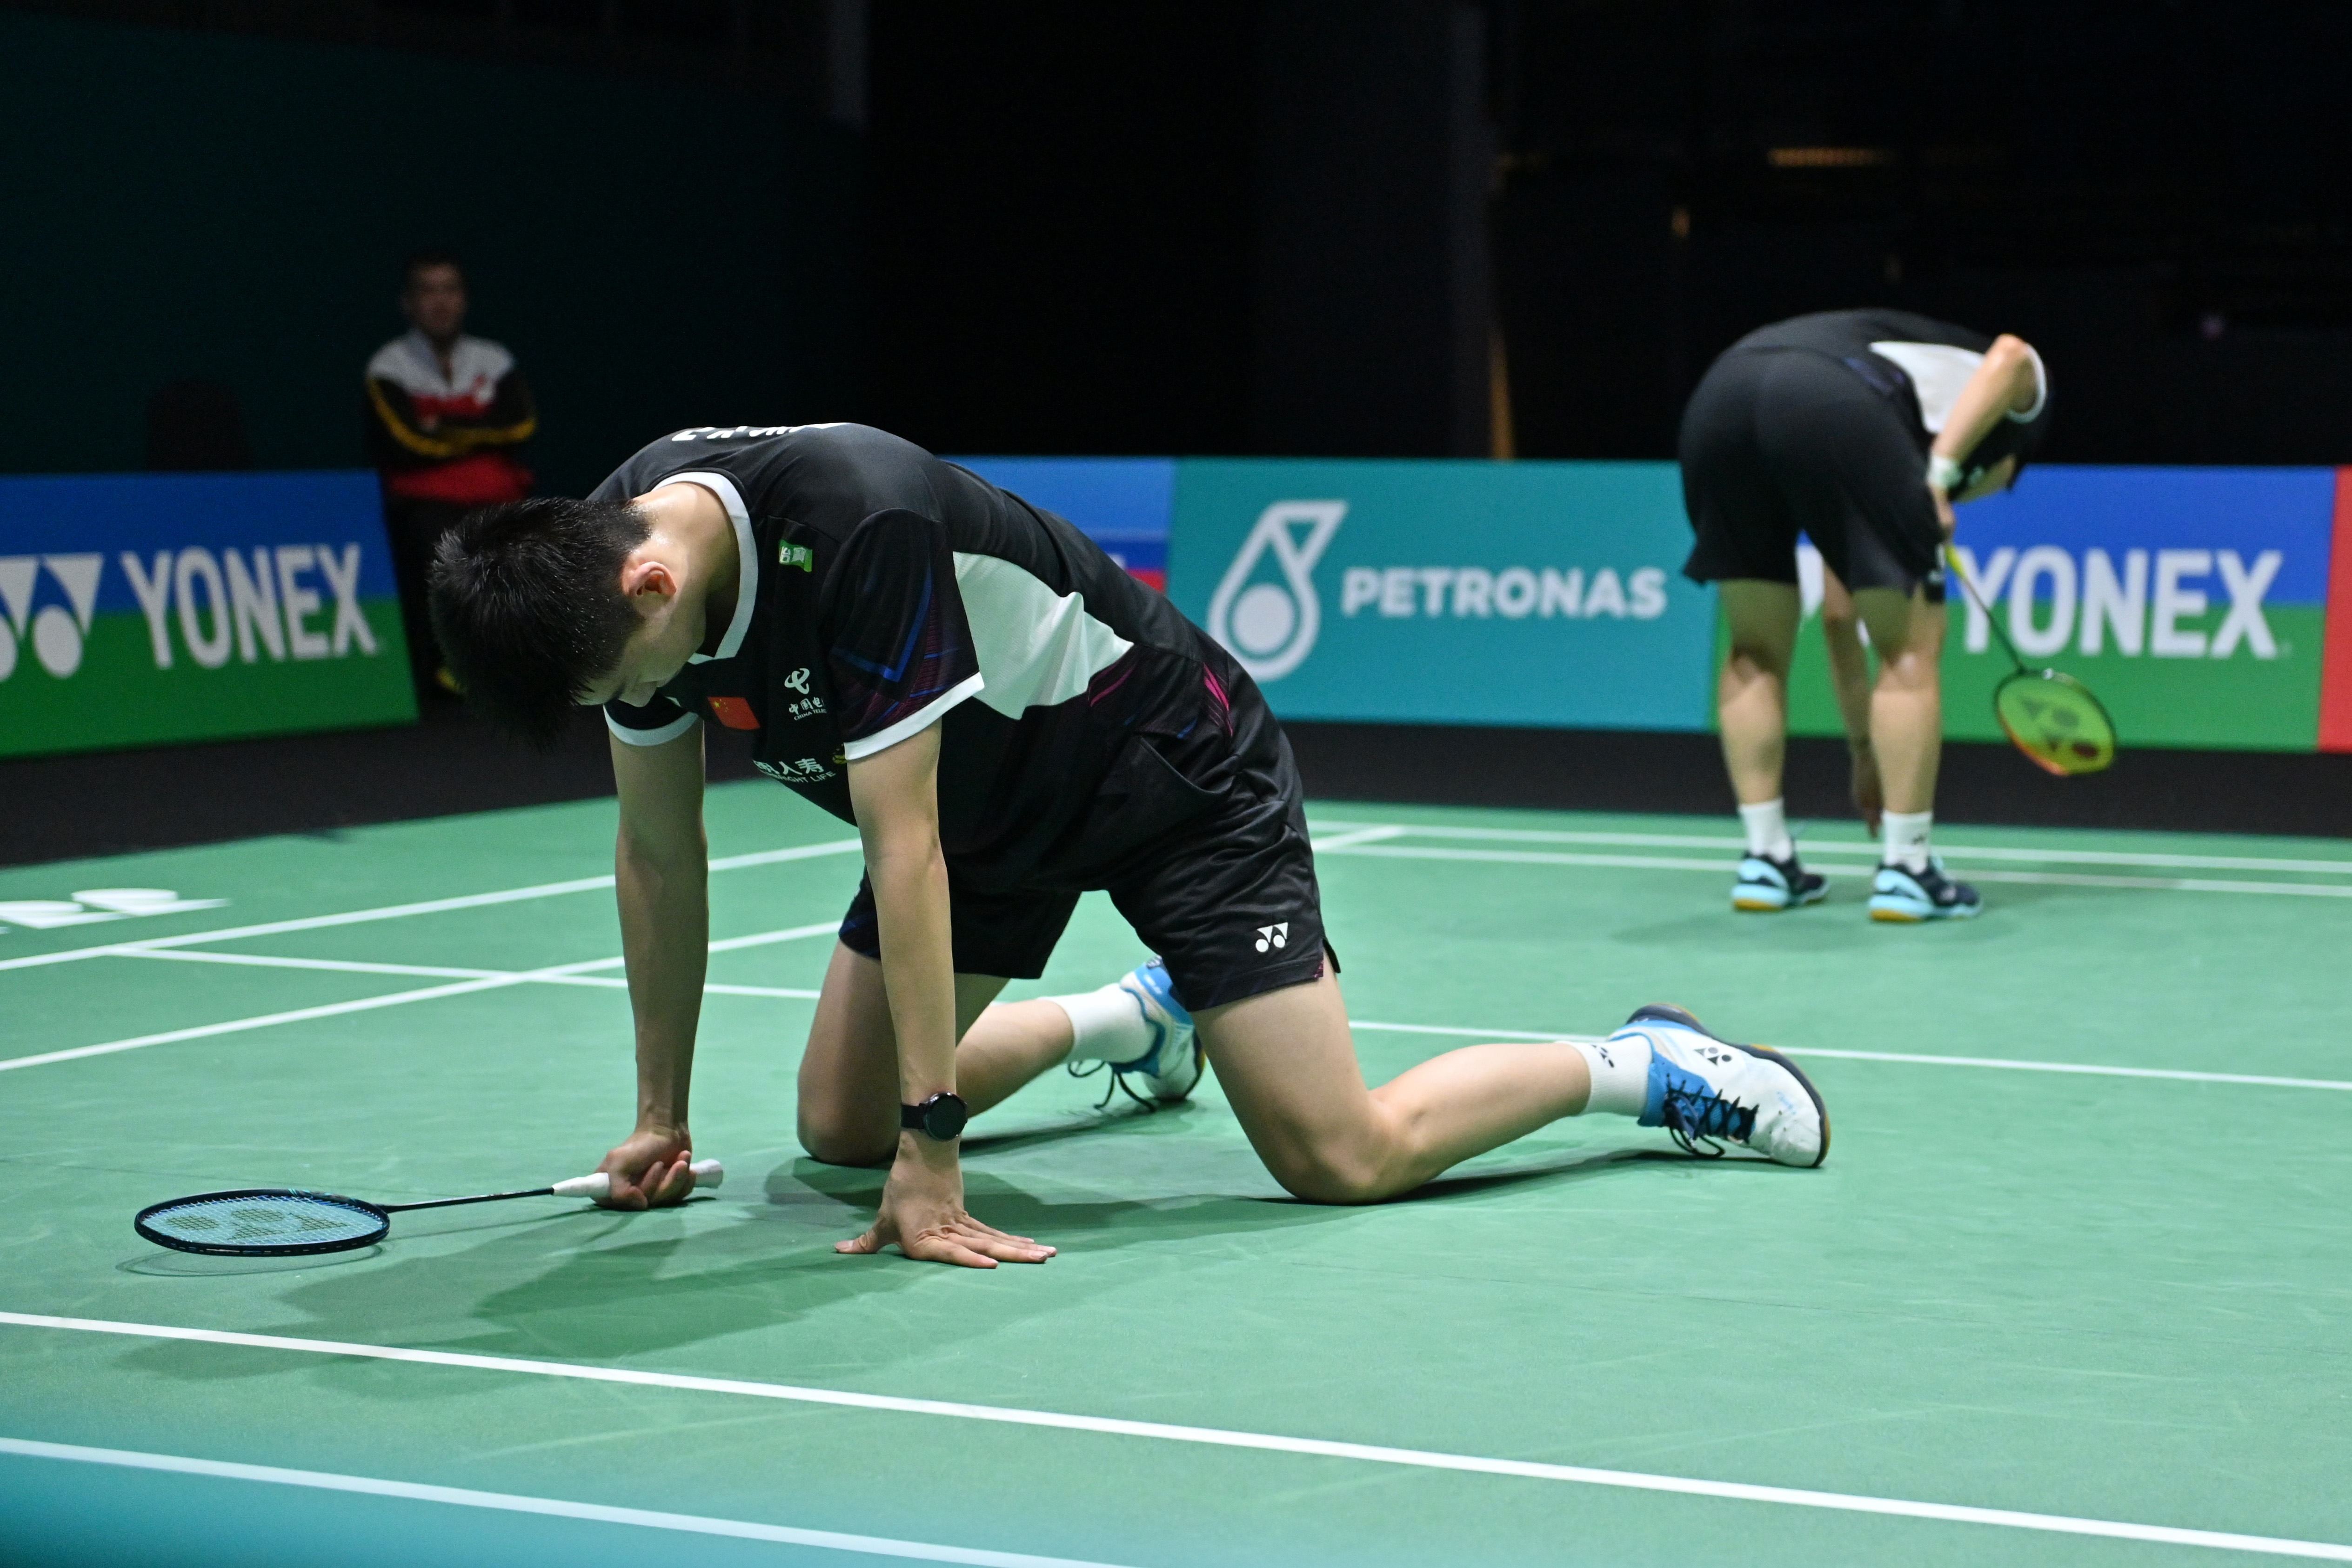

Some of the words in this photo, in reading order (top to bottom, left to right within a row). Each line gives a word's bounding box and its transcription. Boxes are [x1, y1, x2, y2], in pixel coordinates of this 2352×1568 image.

[120, 543, 378, 668] YONEX
[1341, 567, 1668, 619] PETRONAS
[1954, 546, 2283, 659] YONEX
[788, 697, 825, 715] 中国电
[794, 711, 813, 721] CHINA
[810, 770, 836, 782] LIFE
